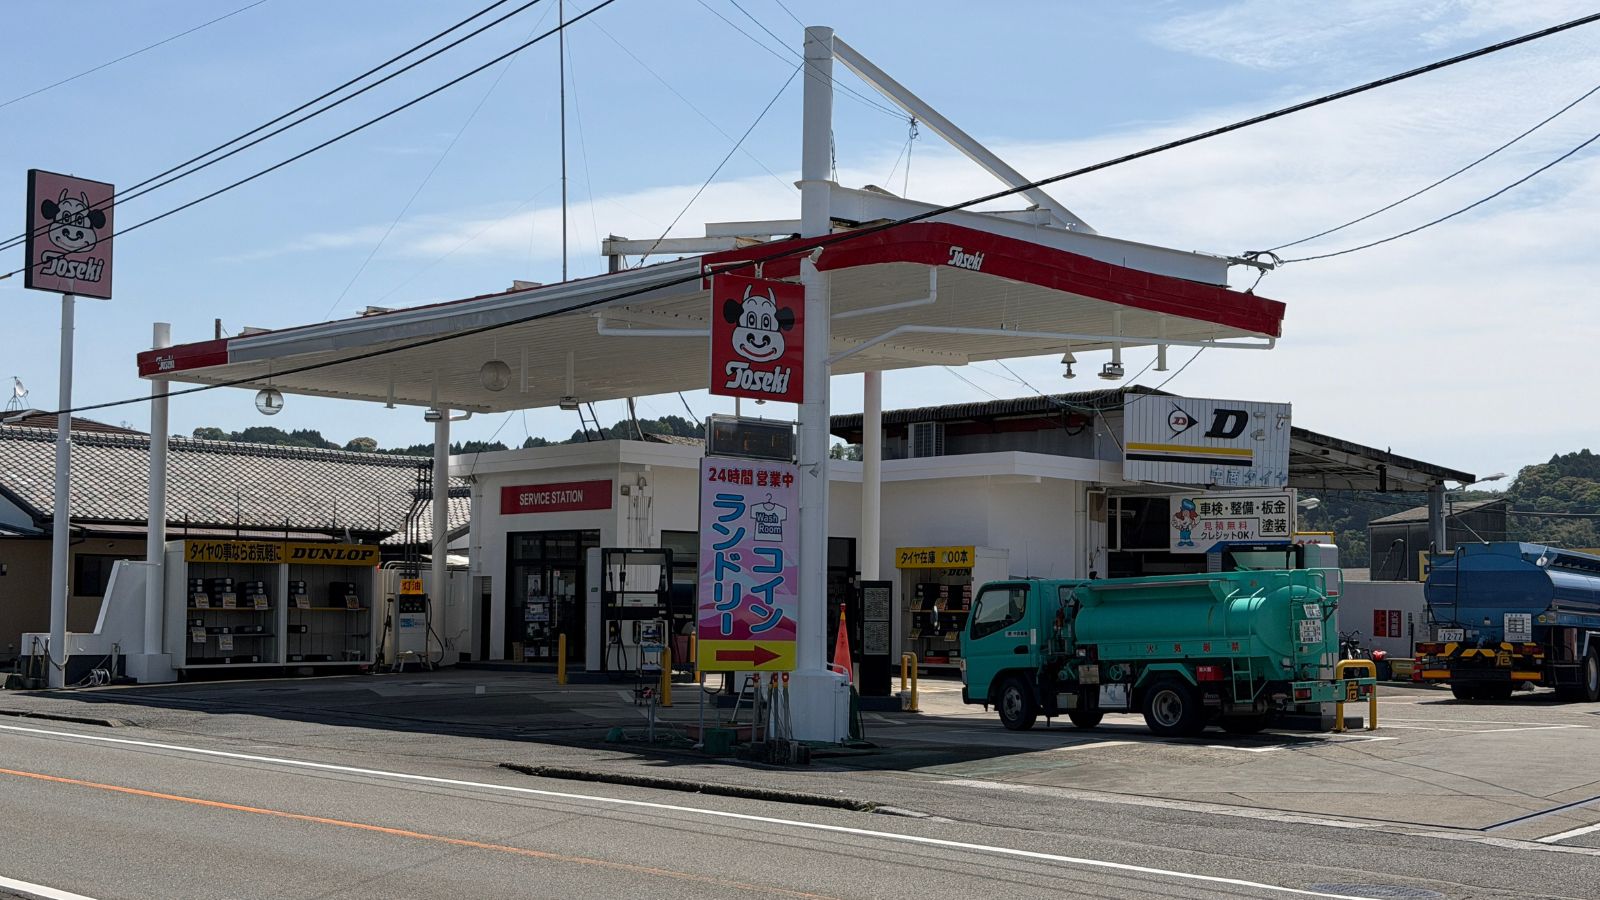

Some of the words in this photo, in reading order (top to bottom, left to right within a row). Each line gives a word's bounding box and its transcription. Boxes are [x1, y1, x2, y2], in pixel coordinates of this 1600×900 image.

[1203, 408, 1249, 439] D
[708, 467, 753, 486] 24時間
[756, 470, 794, 488] 営業中
[519, 491, 550, 506] SERVICE
[551, 489, 583, 504] STATION
[755, 511, 779, 524] Wash
[758, 523, 782, 535] Room
[1204, 520, 1248, 531] 見積無料
[1261, 518, 1287, 533] 塗装
[190, 543, 282, 562] タイヤの事ならお気軽に
[291, 547, 375, 561] DUNLOP
[901, 550, 936, 565] タイヤ在庫
[943, 550, 969, 564] 00本
[711, 492, 747, 636] ランドリー
[402, 580, 421, 591] 灯油
[750, 547, 785, 633] コイン
[1496, 651, 1512, 666] 危
[1347, 681, 1359, 701] 危
